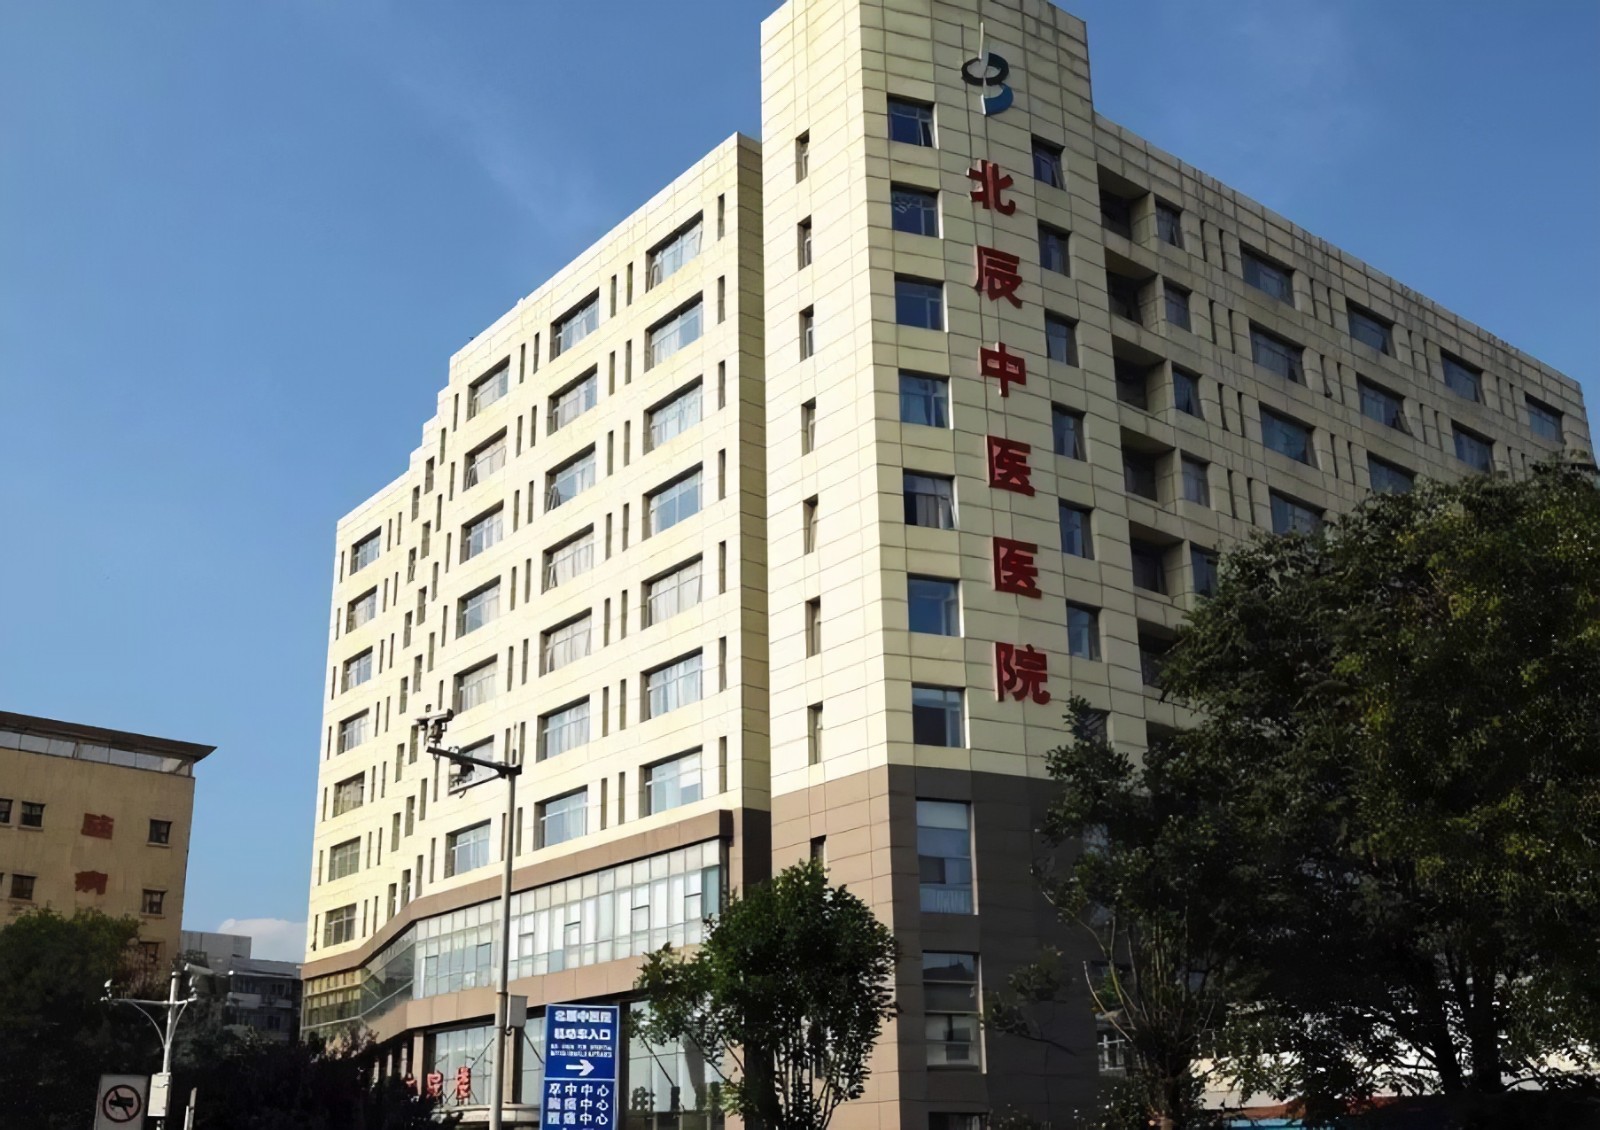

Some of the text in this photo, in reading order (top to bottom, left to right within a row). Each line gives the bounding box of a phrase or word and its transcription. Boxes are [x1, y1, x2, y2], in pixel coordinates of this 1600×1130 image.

[966, 158, 1051, 706] 北辰中医医院
[547, 1097, 610, 1112] 中心
[547, 1111, 609, 1126] 中心
